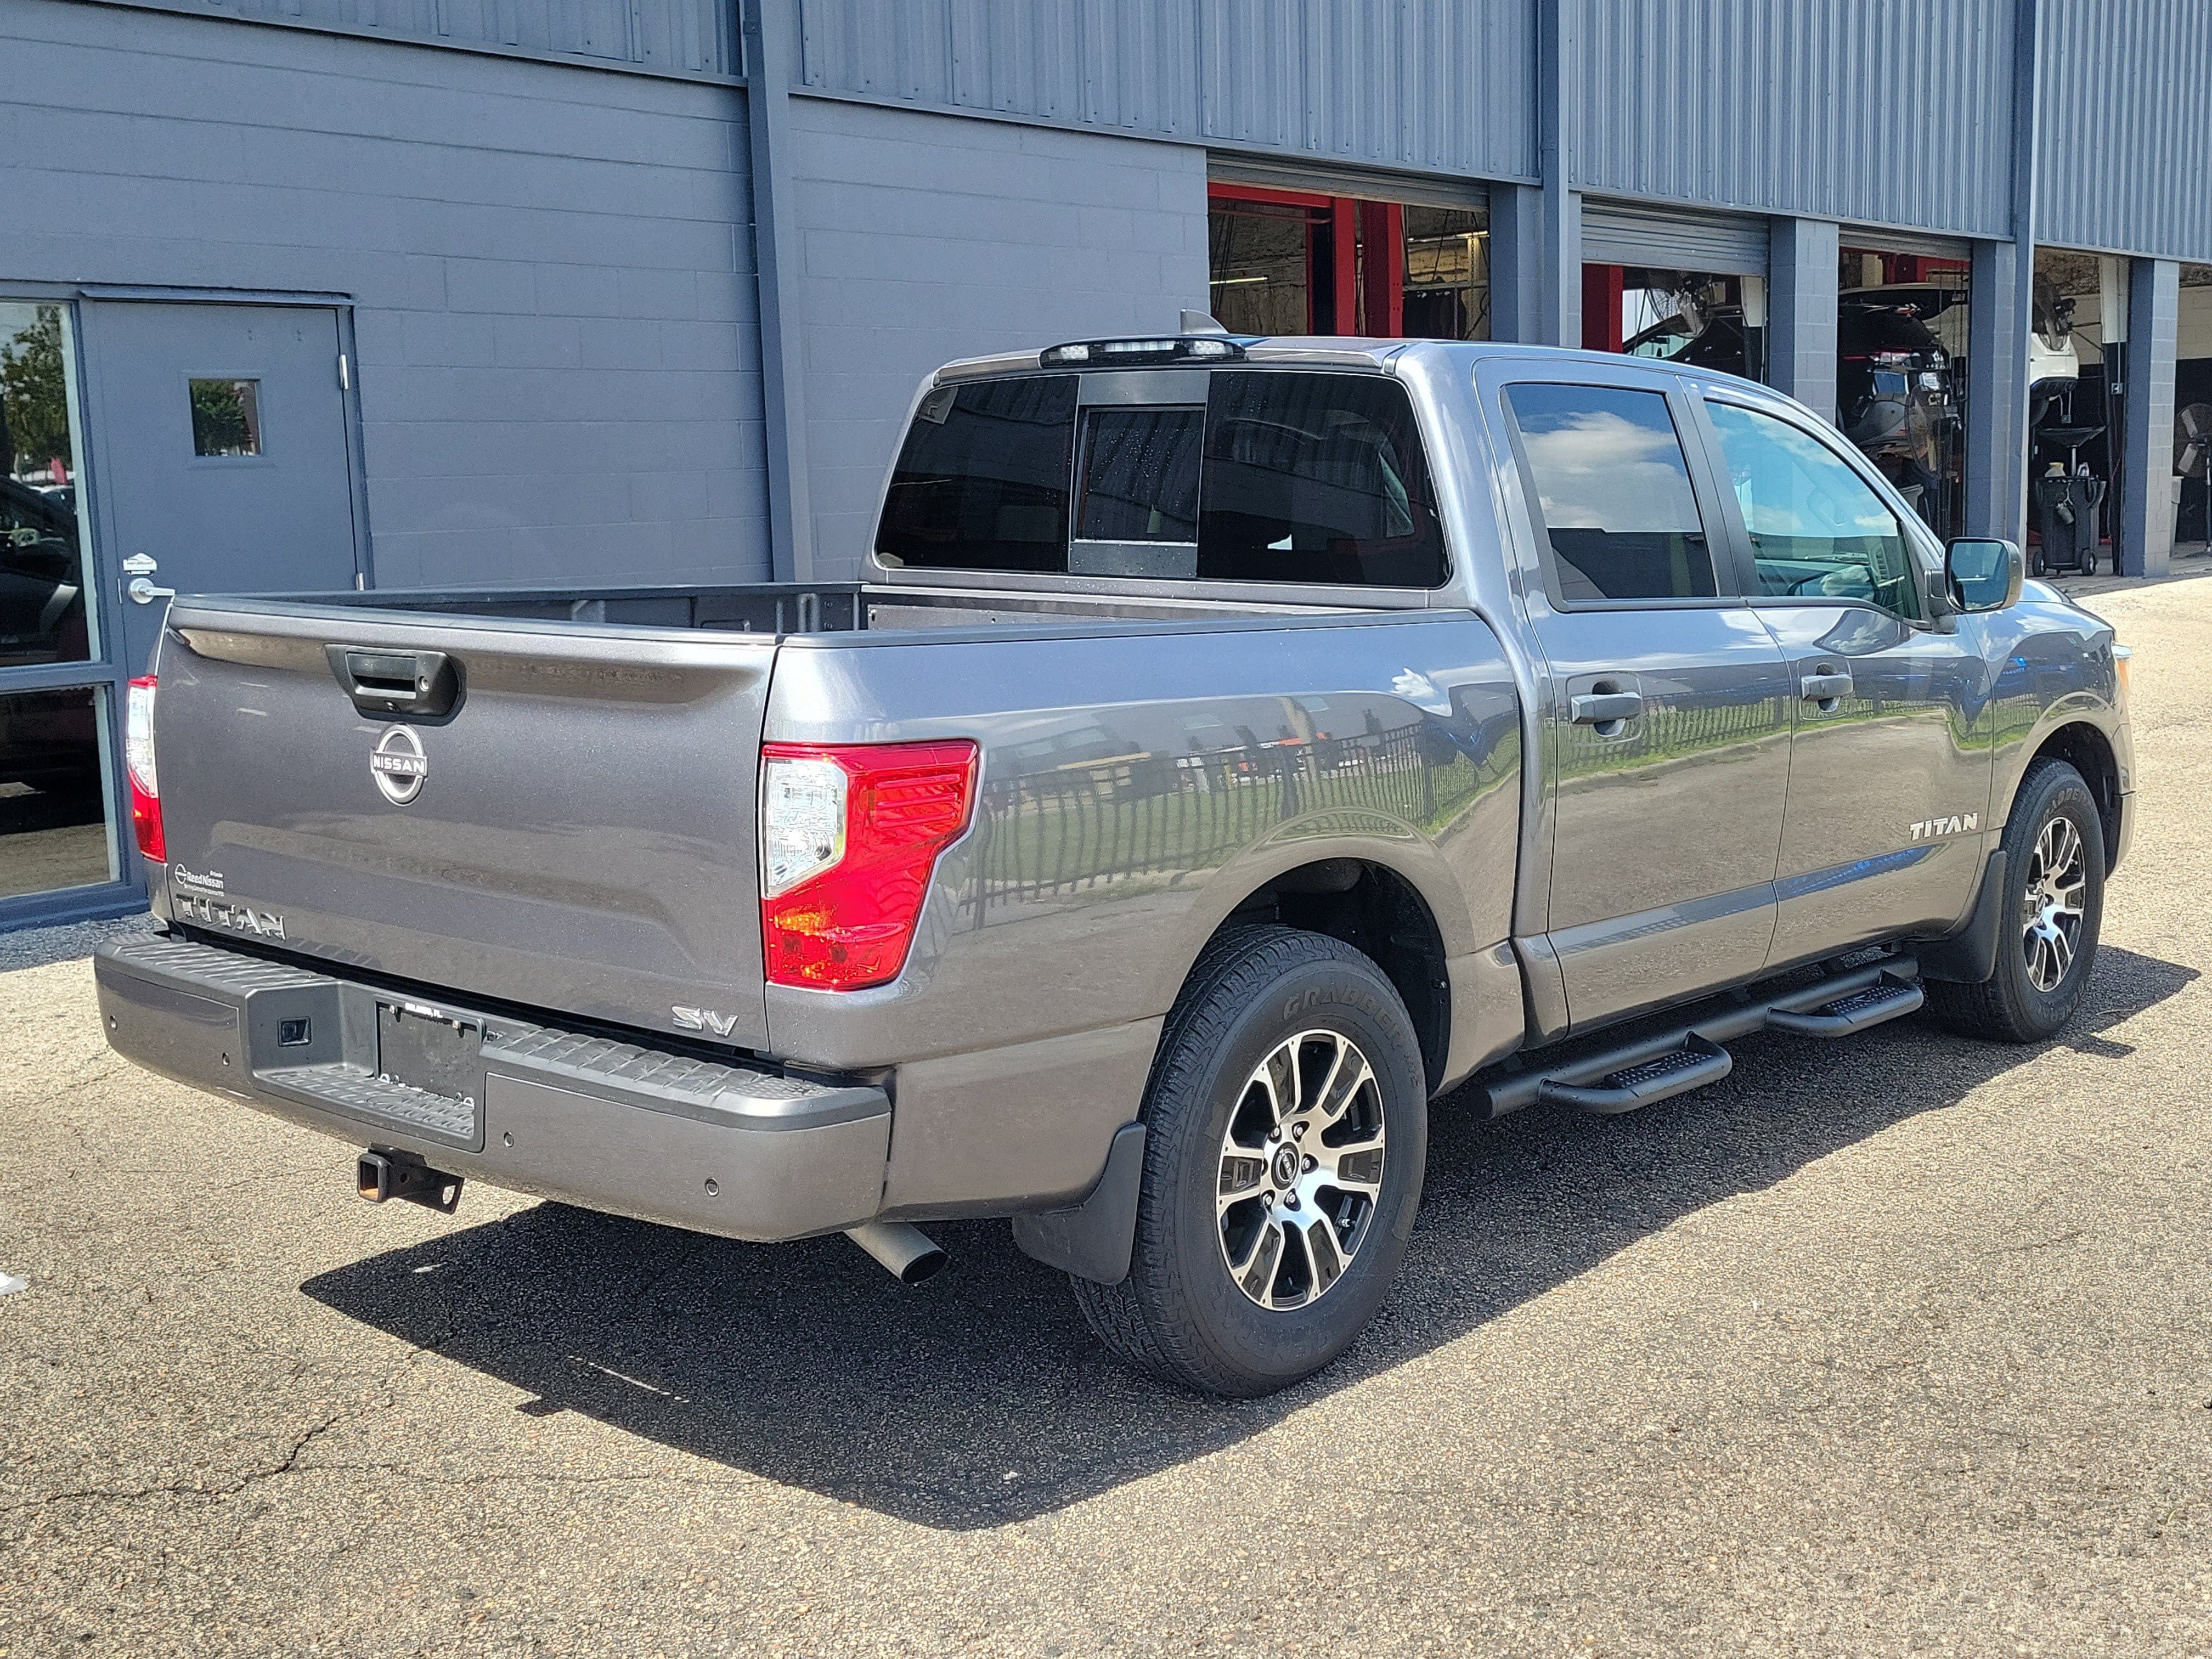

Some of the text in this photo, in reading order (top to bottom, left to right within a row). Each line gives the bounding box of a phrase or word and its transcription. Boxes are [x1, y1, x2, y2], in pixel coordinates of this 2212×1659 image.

[373, 754, 425, 774] NISSAN
[1909, 812, 1978, 841] TITAN
[176, 894, 286, 940] TITAN
[672, 1005, 738, 1037] SV
